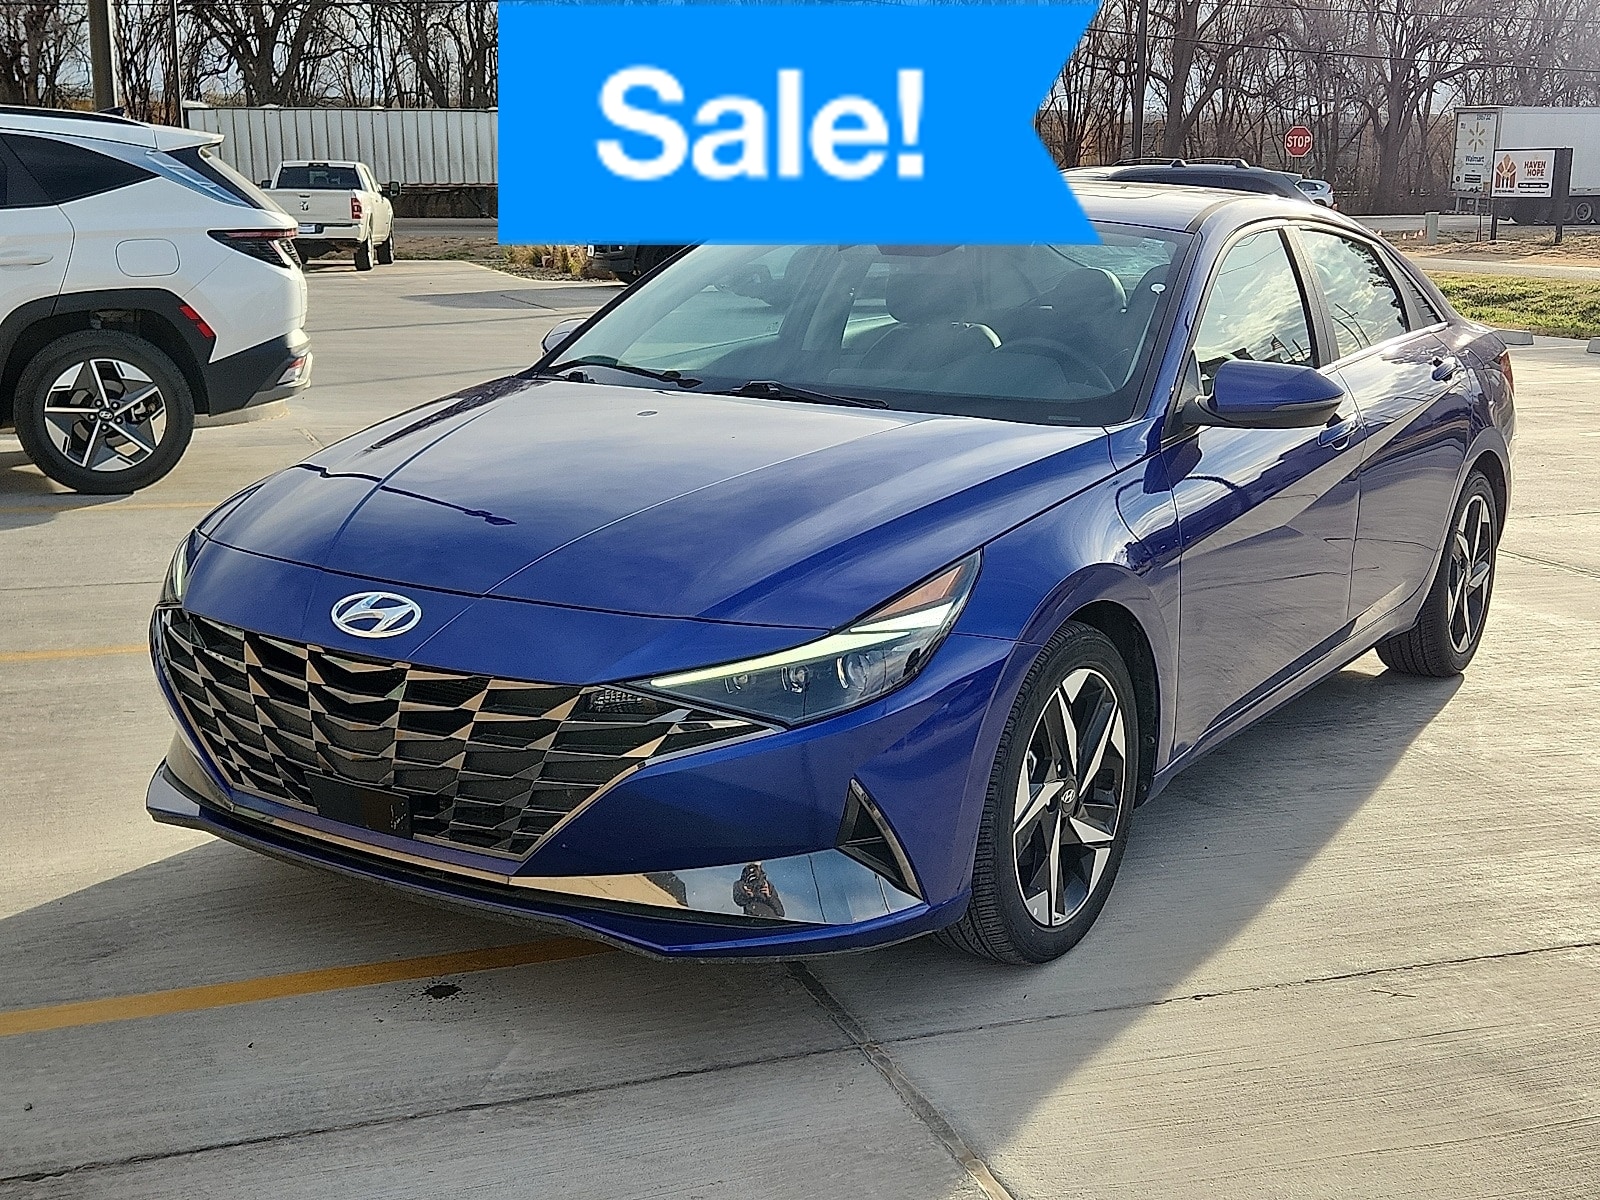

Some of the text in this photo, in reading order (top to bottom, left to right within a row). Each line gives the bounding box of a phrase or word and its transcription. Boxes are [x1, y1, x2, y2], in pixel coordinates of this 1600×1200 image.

[1286, 135, 1311, 148] STOP
[1523, 160, 1547, 169] HAVEN
[1526, 169, 1545, 177] HOPE
